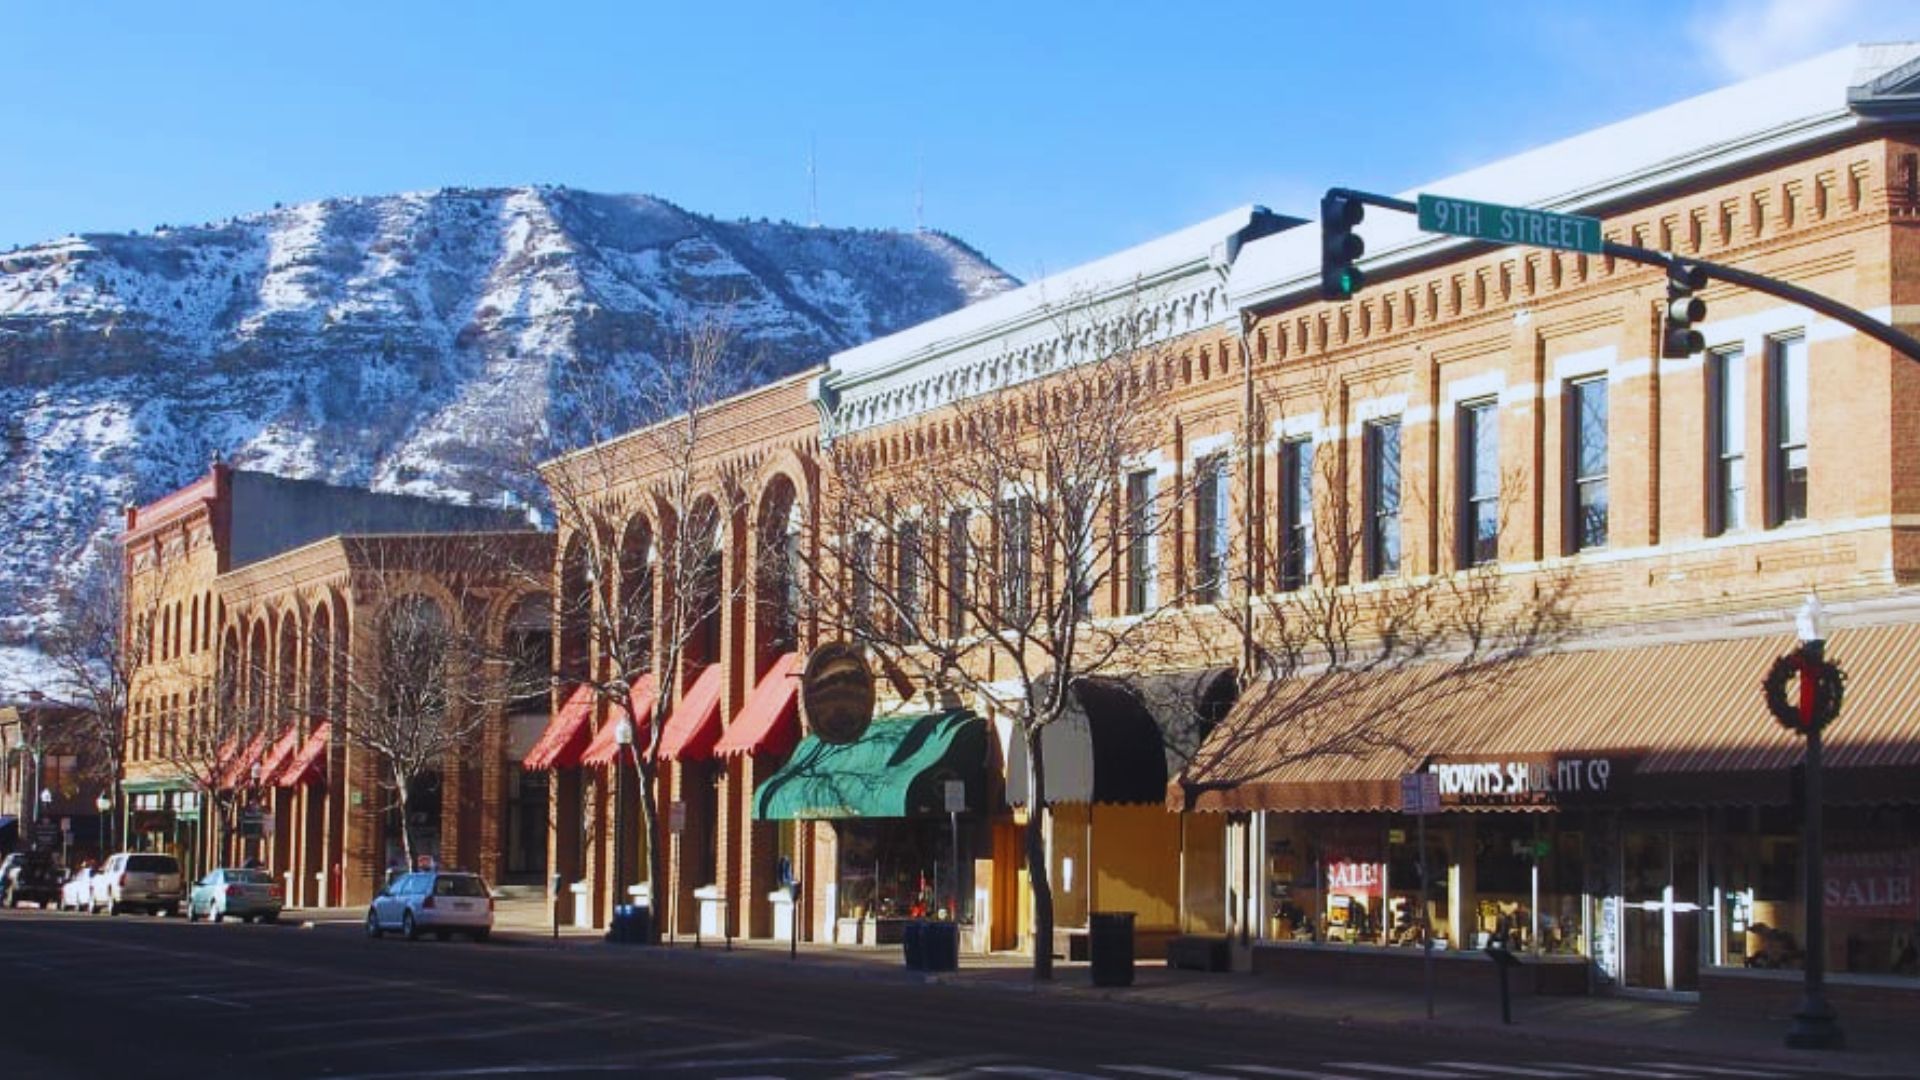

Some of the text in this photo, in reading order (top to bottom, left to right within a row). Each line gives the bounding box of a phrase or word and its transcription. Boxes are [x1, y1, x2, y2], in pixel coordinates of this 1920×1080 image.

[1435, 201, 1585, 249] 9TH STREET
[1429, 763, 1503, 794] ROWN'S
